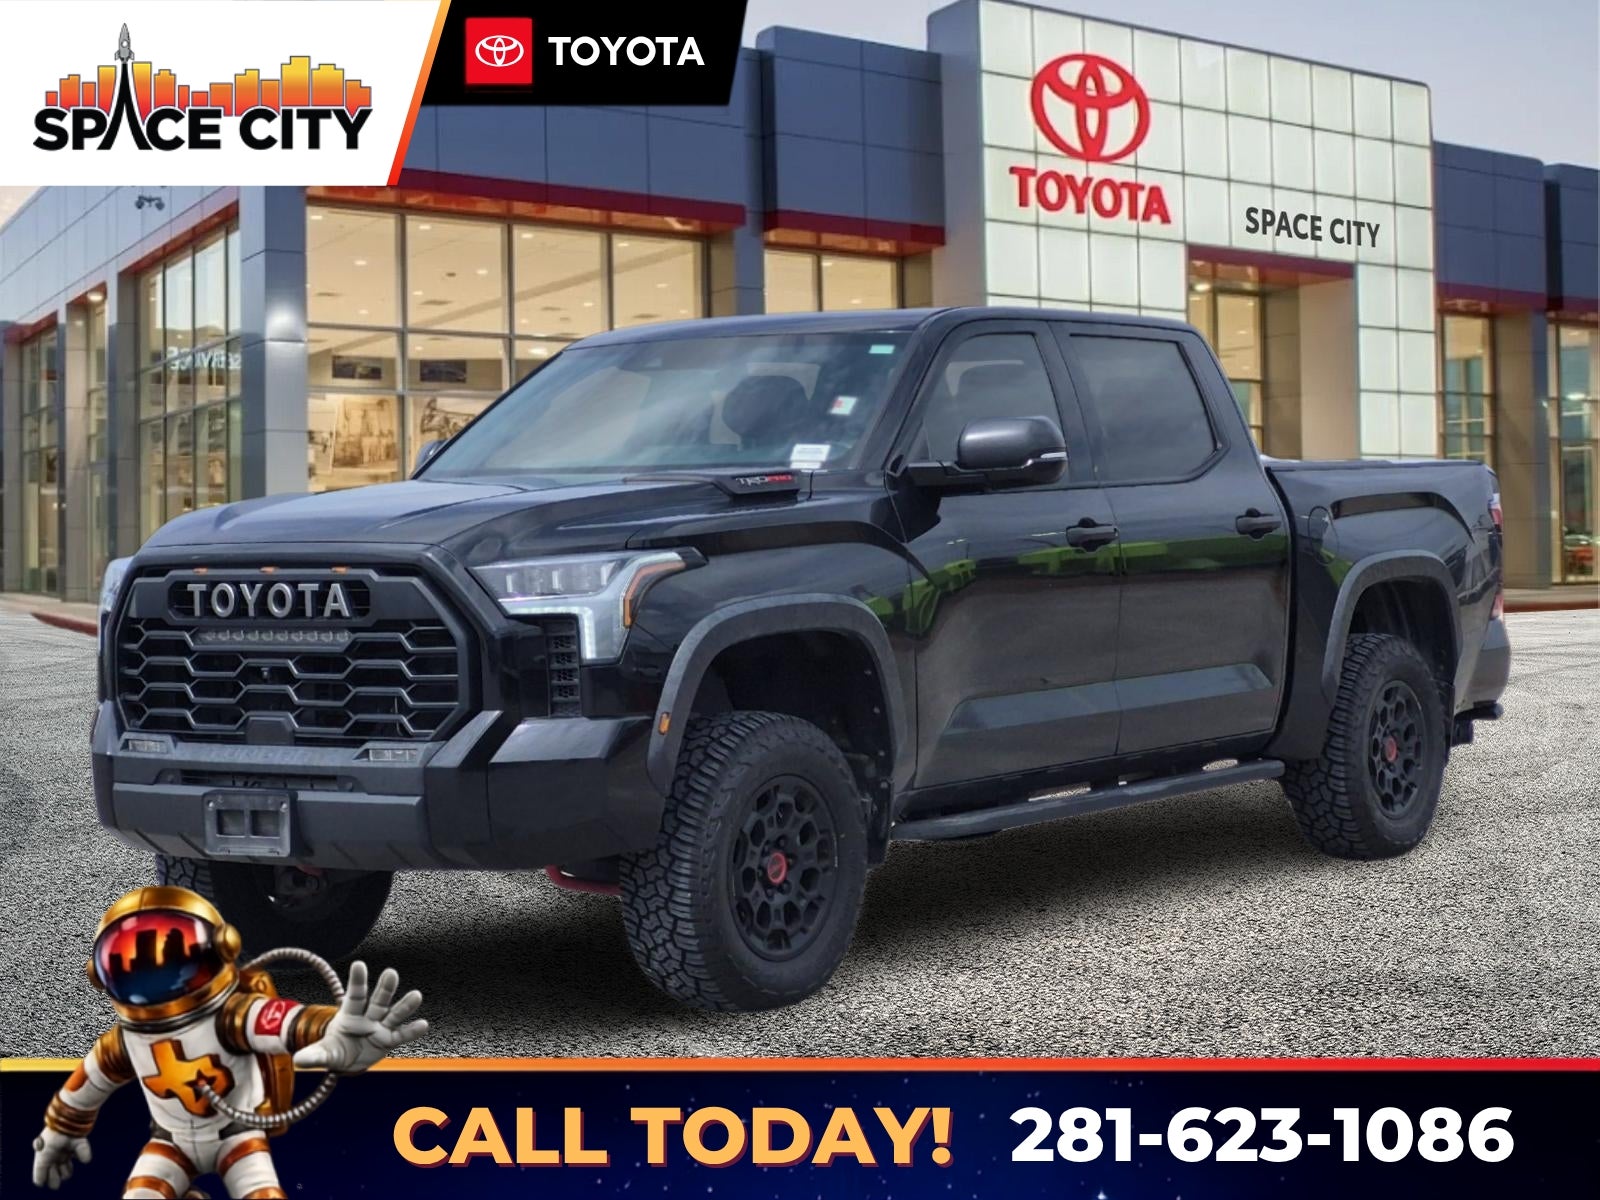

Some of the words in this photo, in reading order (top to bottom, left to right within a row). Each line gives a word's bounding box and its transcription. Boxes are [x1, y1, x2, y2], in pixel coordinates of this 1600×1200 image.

[1009, 166, 1172, 224] TOYOTA
[1245, 207, 1322, 242] SPACE
[1329, 218, 1380, 248] CITY
[187, 583, 350, 618] TOYOTA
